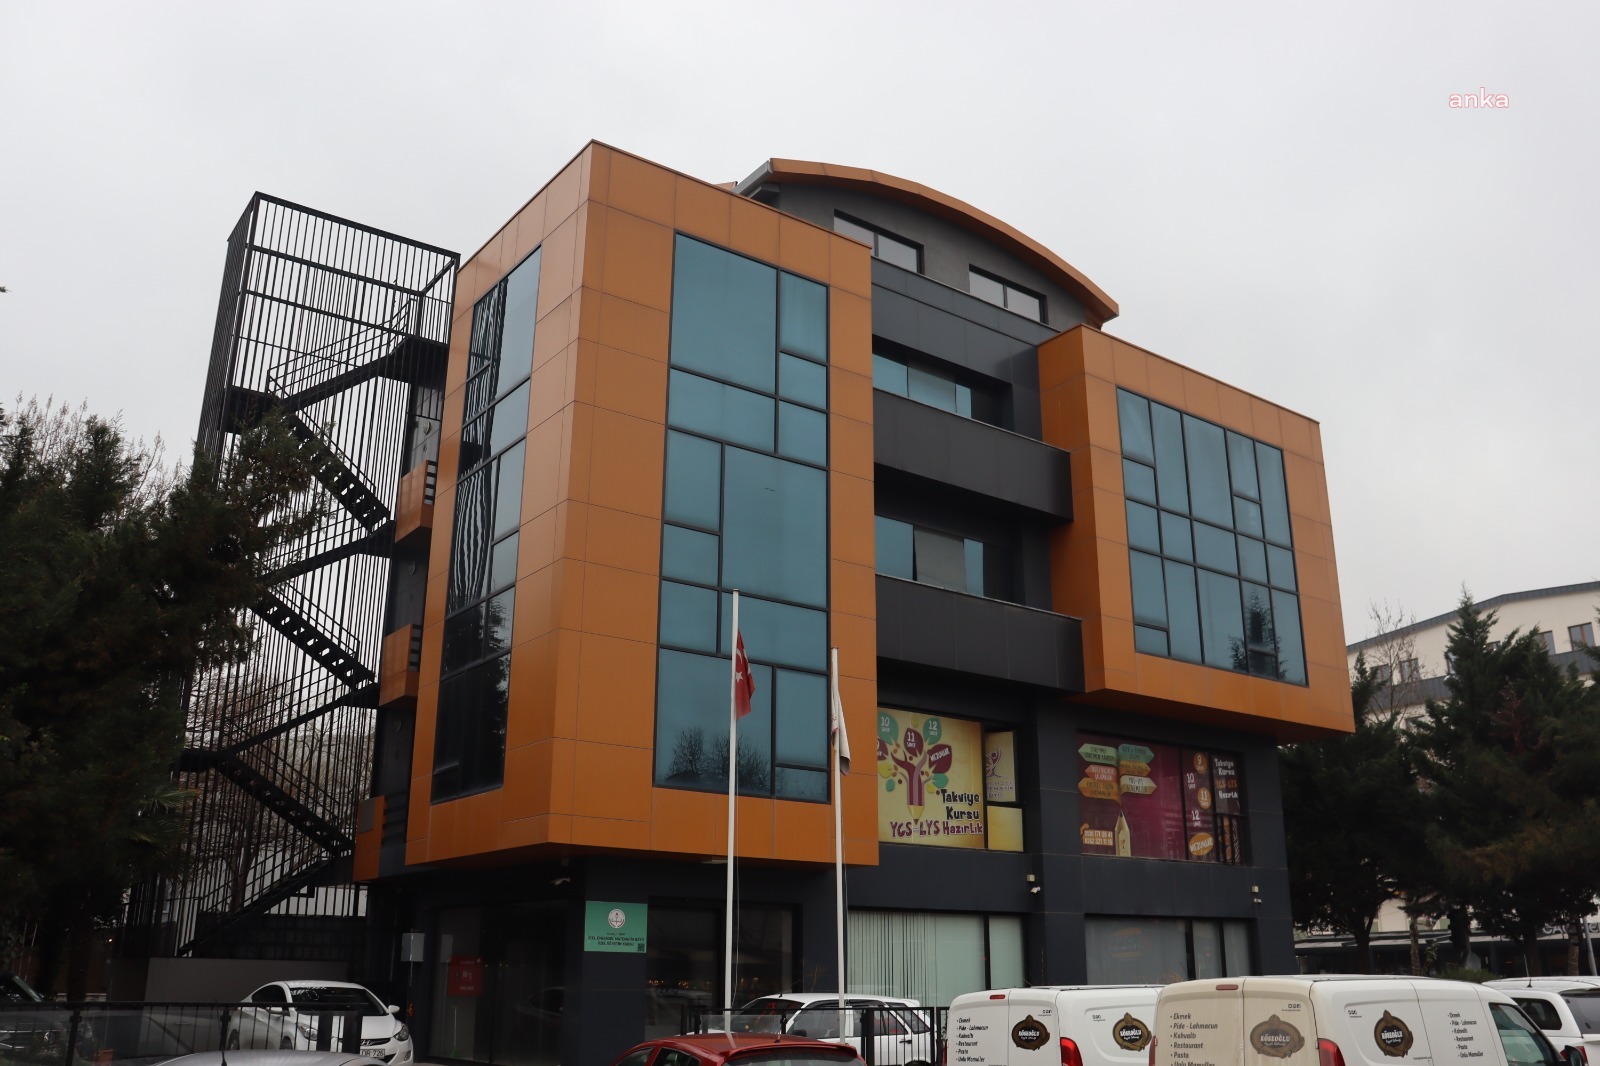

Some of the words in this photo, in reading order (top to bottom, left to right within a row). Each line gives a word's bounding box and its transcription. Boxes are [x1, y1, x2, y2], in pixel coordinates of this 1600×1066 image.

[881, 716, 889, 726] 10
[929, 720, 937, 730] 12
[907, 732, 915, 742] 11
[1186, 773, 1194, 783] 10
[941, 789, 980, 806] Takviye
[1201, 790, 1207, 800] 11
[946, 806, 979, 820] Kursu
[1192, 810, 1200, 820] 12
[1261, 1034, 1290, 1042] KÖSEOĞLU
